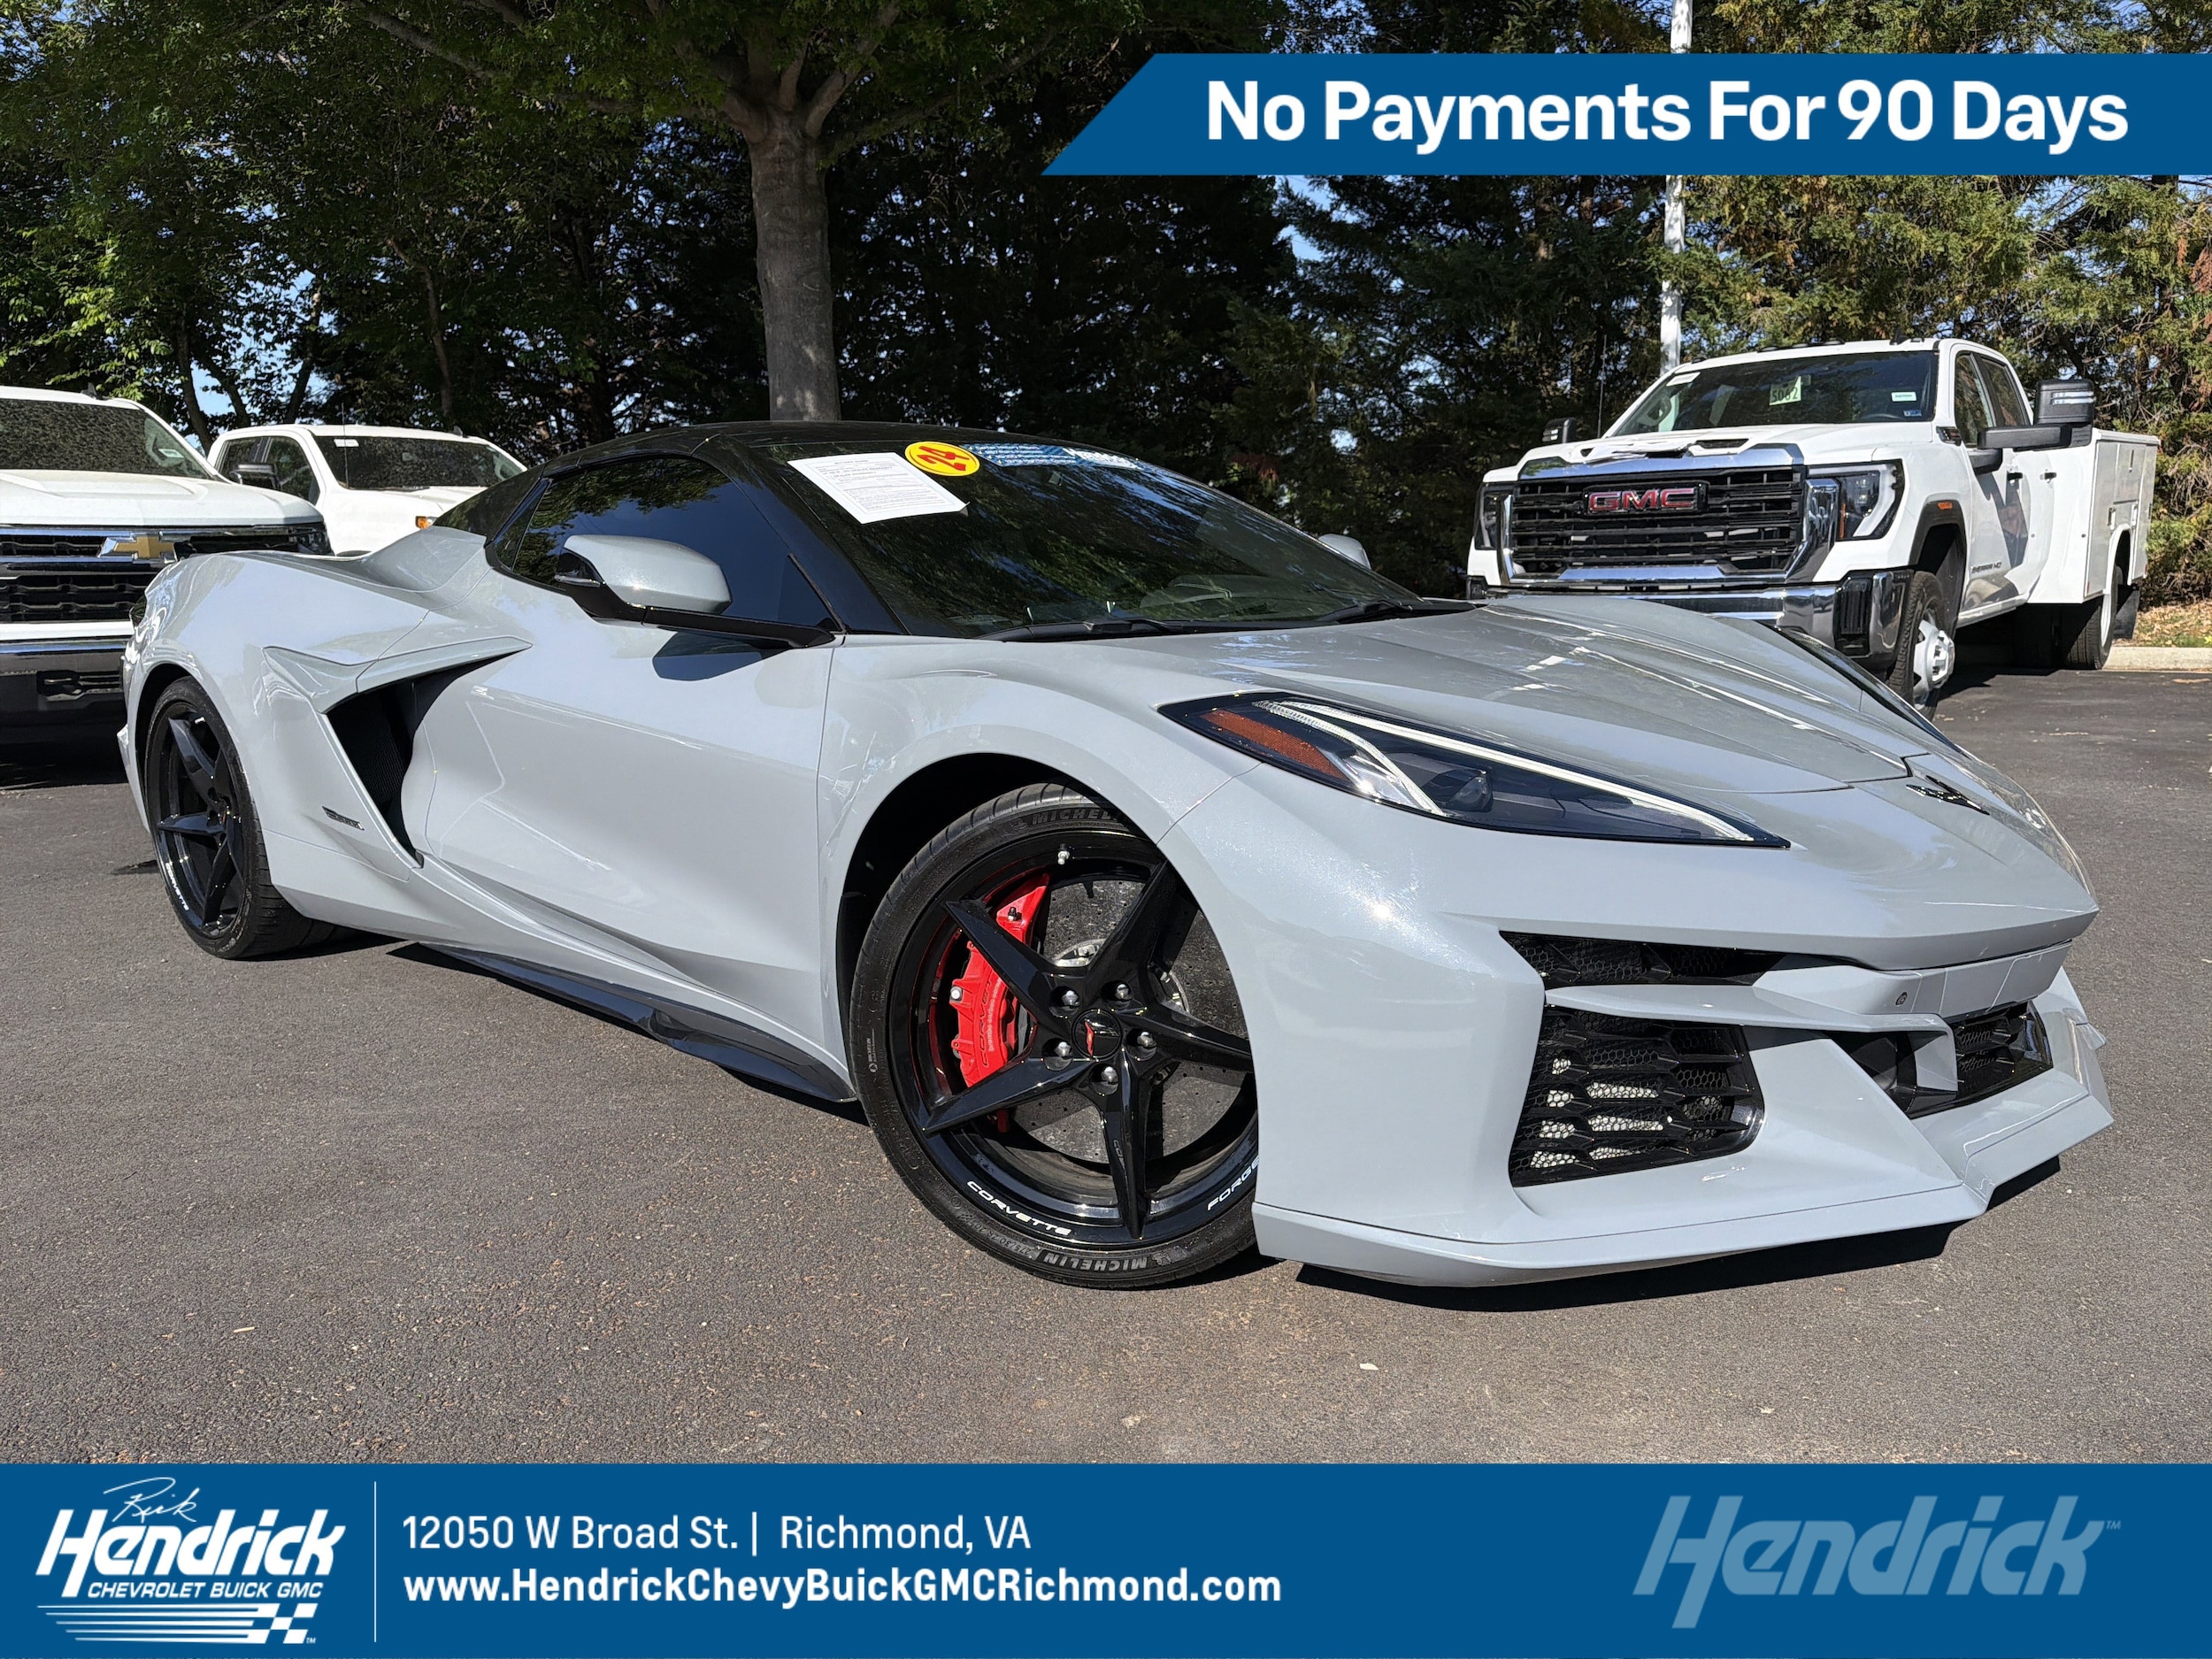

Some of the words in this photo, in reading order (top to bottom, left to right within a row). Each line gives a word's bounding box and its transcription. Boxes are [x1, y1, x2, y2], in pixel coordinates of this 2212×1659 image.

[1772, 388, 1798, 402] 5062
[917, 445, 971, 472] 24
[1589, 488, 1695, 511] GMC
[1032, 808, 1112, 825] MICHEL
[979, 970, 992, 1067] CORVET
[1207, 1155, 1259, 1211] FORGE
[966, 1180, 1072, 1236] CORVETTE
[1044, 1253, 1148, 1271] MICHELIN
